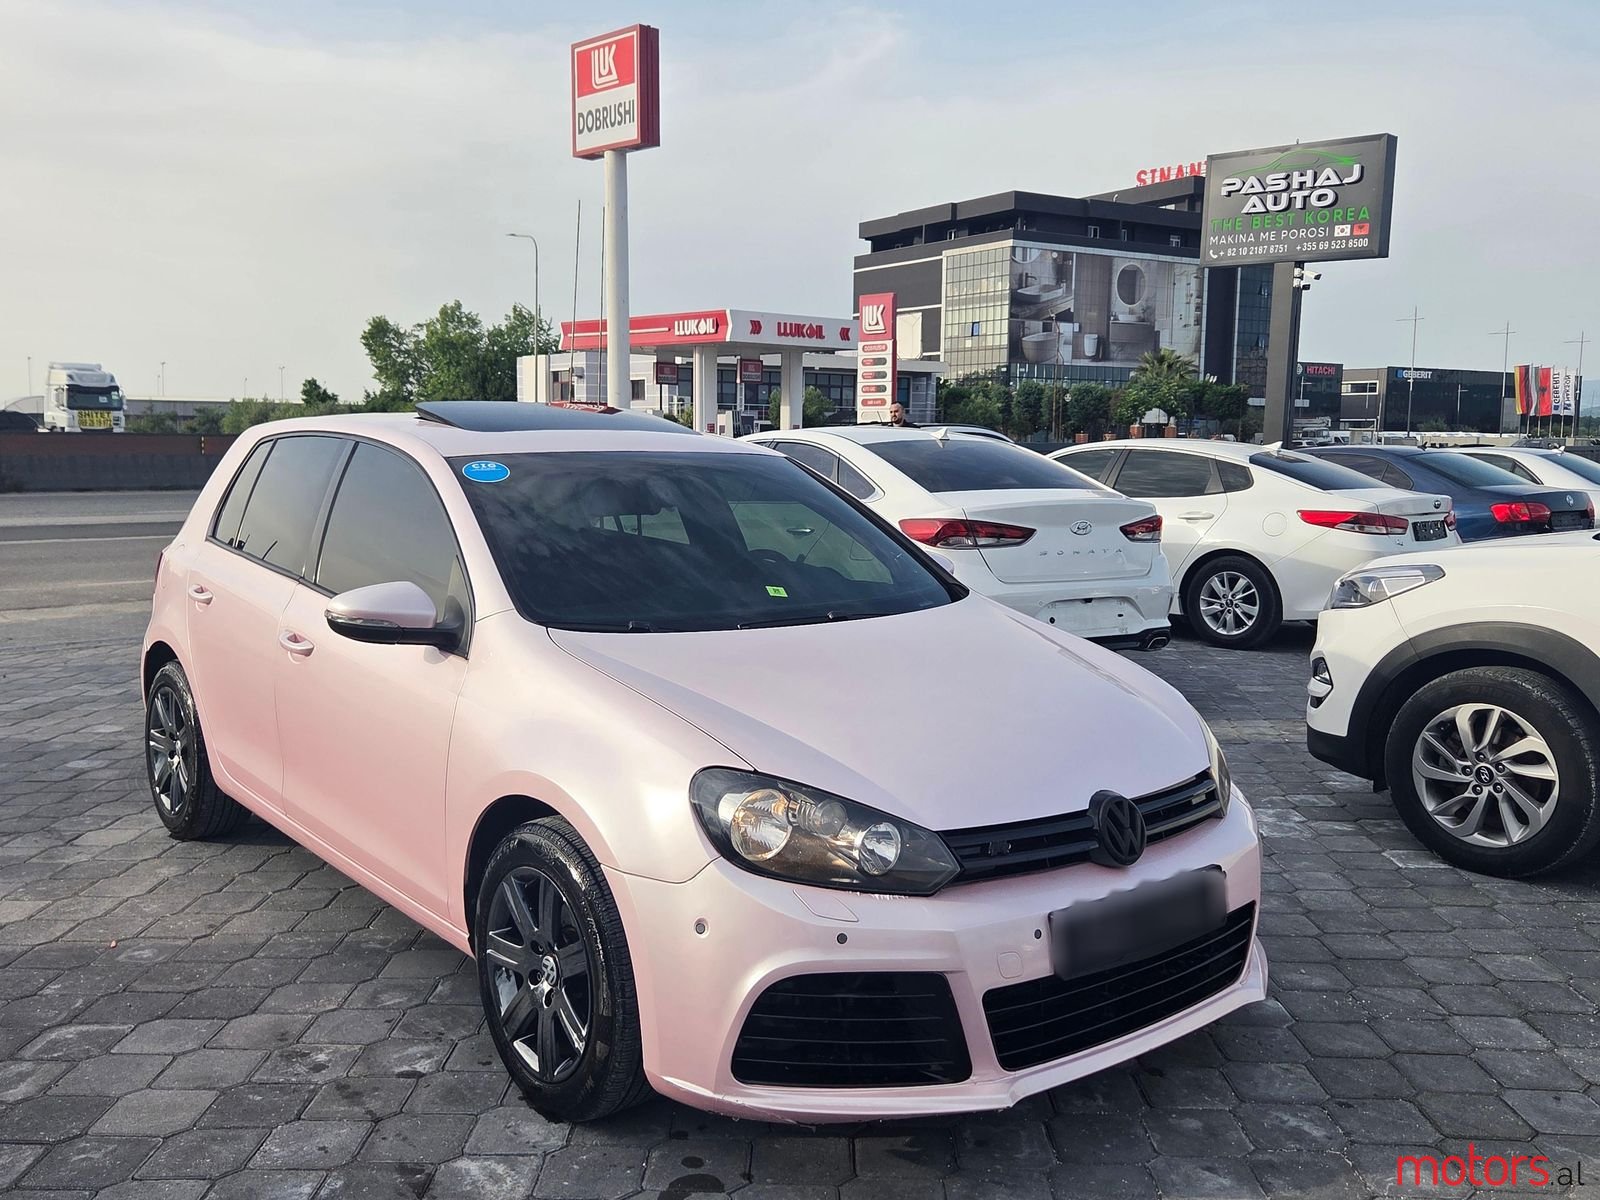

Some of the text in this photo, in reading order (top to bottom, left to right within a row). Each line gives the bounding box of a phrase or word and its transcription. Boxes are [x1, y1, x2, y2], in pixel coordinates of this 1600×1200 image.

[577, 99, 635, 135] DOBRUSHI
[1220, 164, 1363, 196] PASHAJ
[1241, 188, 1337, 214] AUTO
[1211, 207, 1370, 232] THE BEST KOREA
[1210, 227, 1329, 246] MAKINA ME POROSI
[1227, 247, 1237, 256] 82
[1239, 246, 1248, 256] 10
[1250, 245, 1267, 255] 2187
[1270, 244, 1288, 254] 8751
[1296, 241, 1317, 252] +355
[1319, 240, 1329, 250] 69
[1331, 239, 1346, 249] 523
[1348, 238, 1369, 248] 8500
[1306, 366, 1336, 376] HITACHI
[1402, 369, 1433, 379] GEBERIT
[1039, 548, 1123, 556] SONATA
